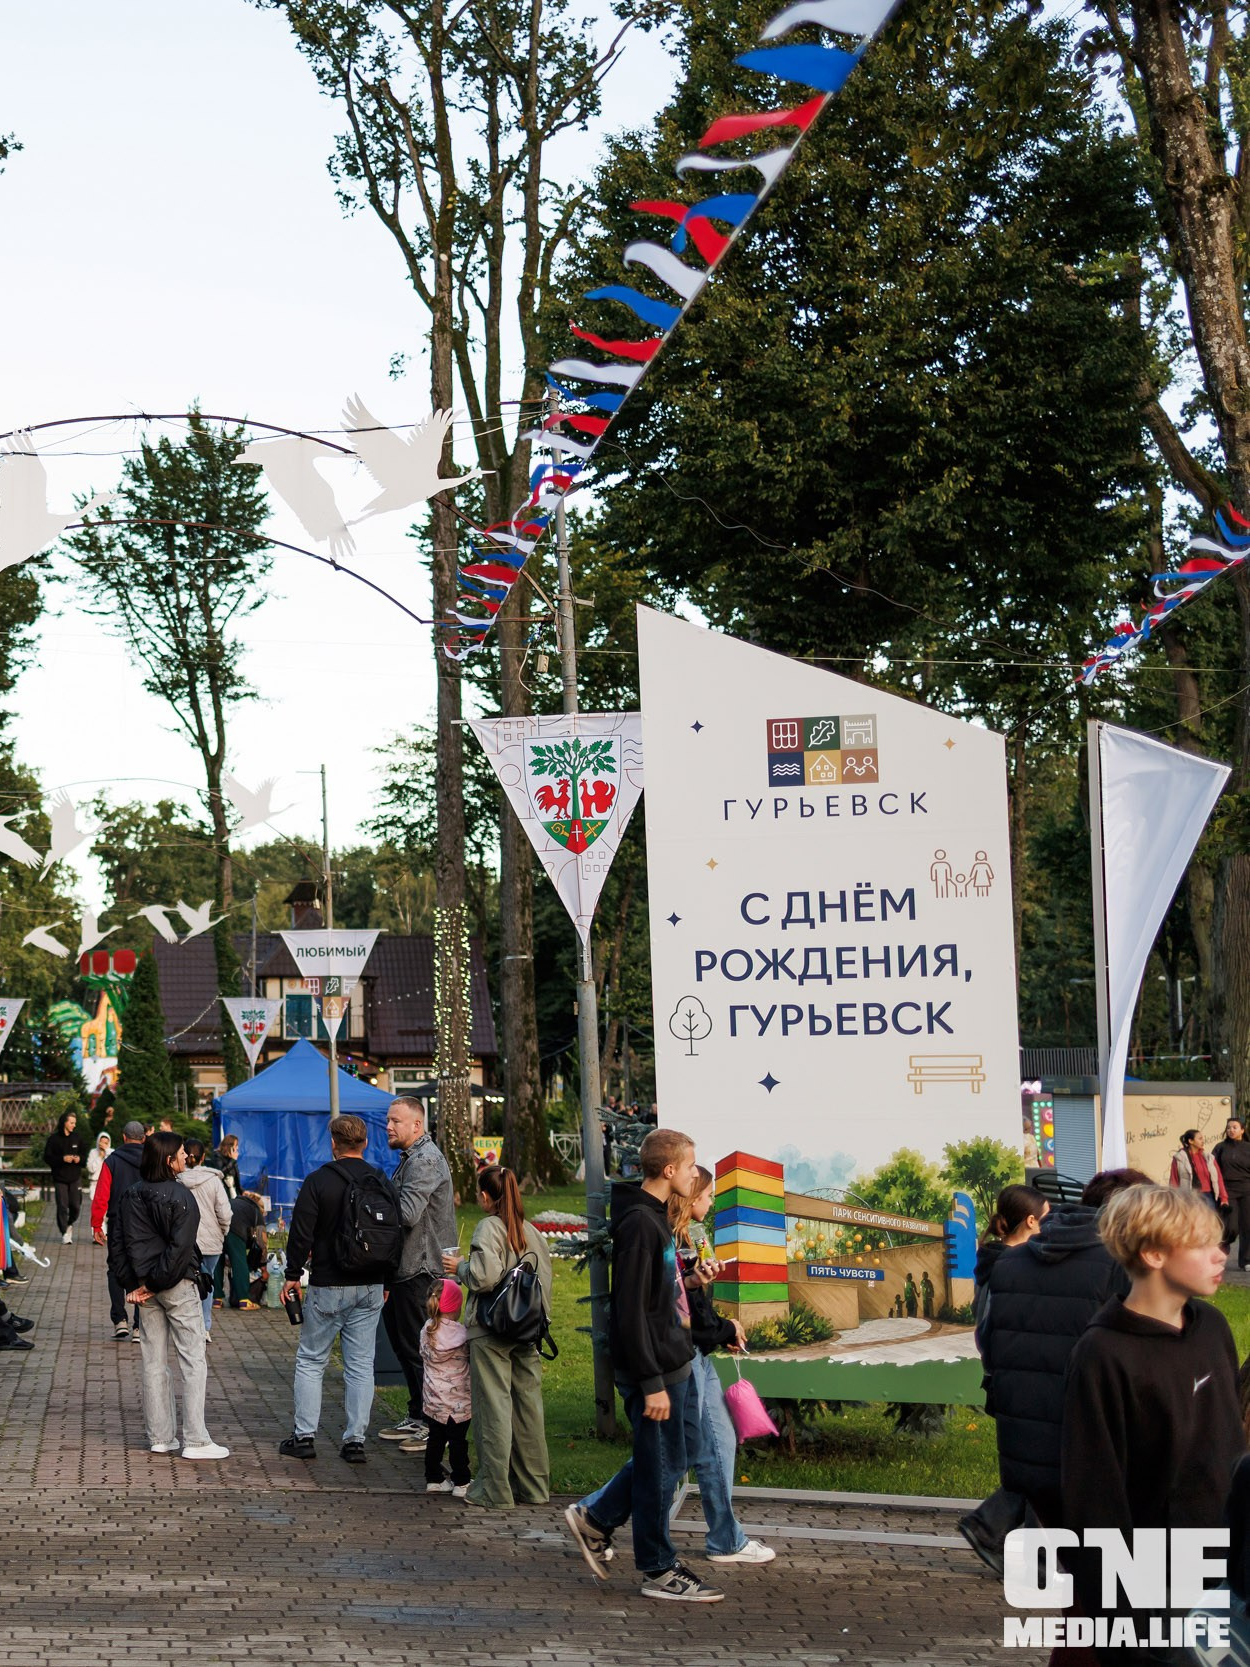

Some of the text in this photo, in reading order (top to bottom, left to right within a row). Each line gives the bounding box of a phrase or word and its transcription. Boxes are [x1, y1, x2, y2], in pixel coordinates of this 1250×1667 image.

[722, 790, 930, 822] ГУРЬЕВСК
[739, 882, 917, 931] С ДНЁМ
[295, 943, 367, 958] ЛЮБИМЫЙ
[694, 943, 973, 985] РОЖДЕНИЯ,
[728, 1000, 955, 1039] ГУРЬЕВСК
[832, 1206, 929, 1233] ПАРК СЕНСИТИВНОГО РАЗВИТИЯ
[810, 1265, 877, 1280] ПЯТЬ ЧУВСТВ
